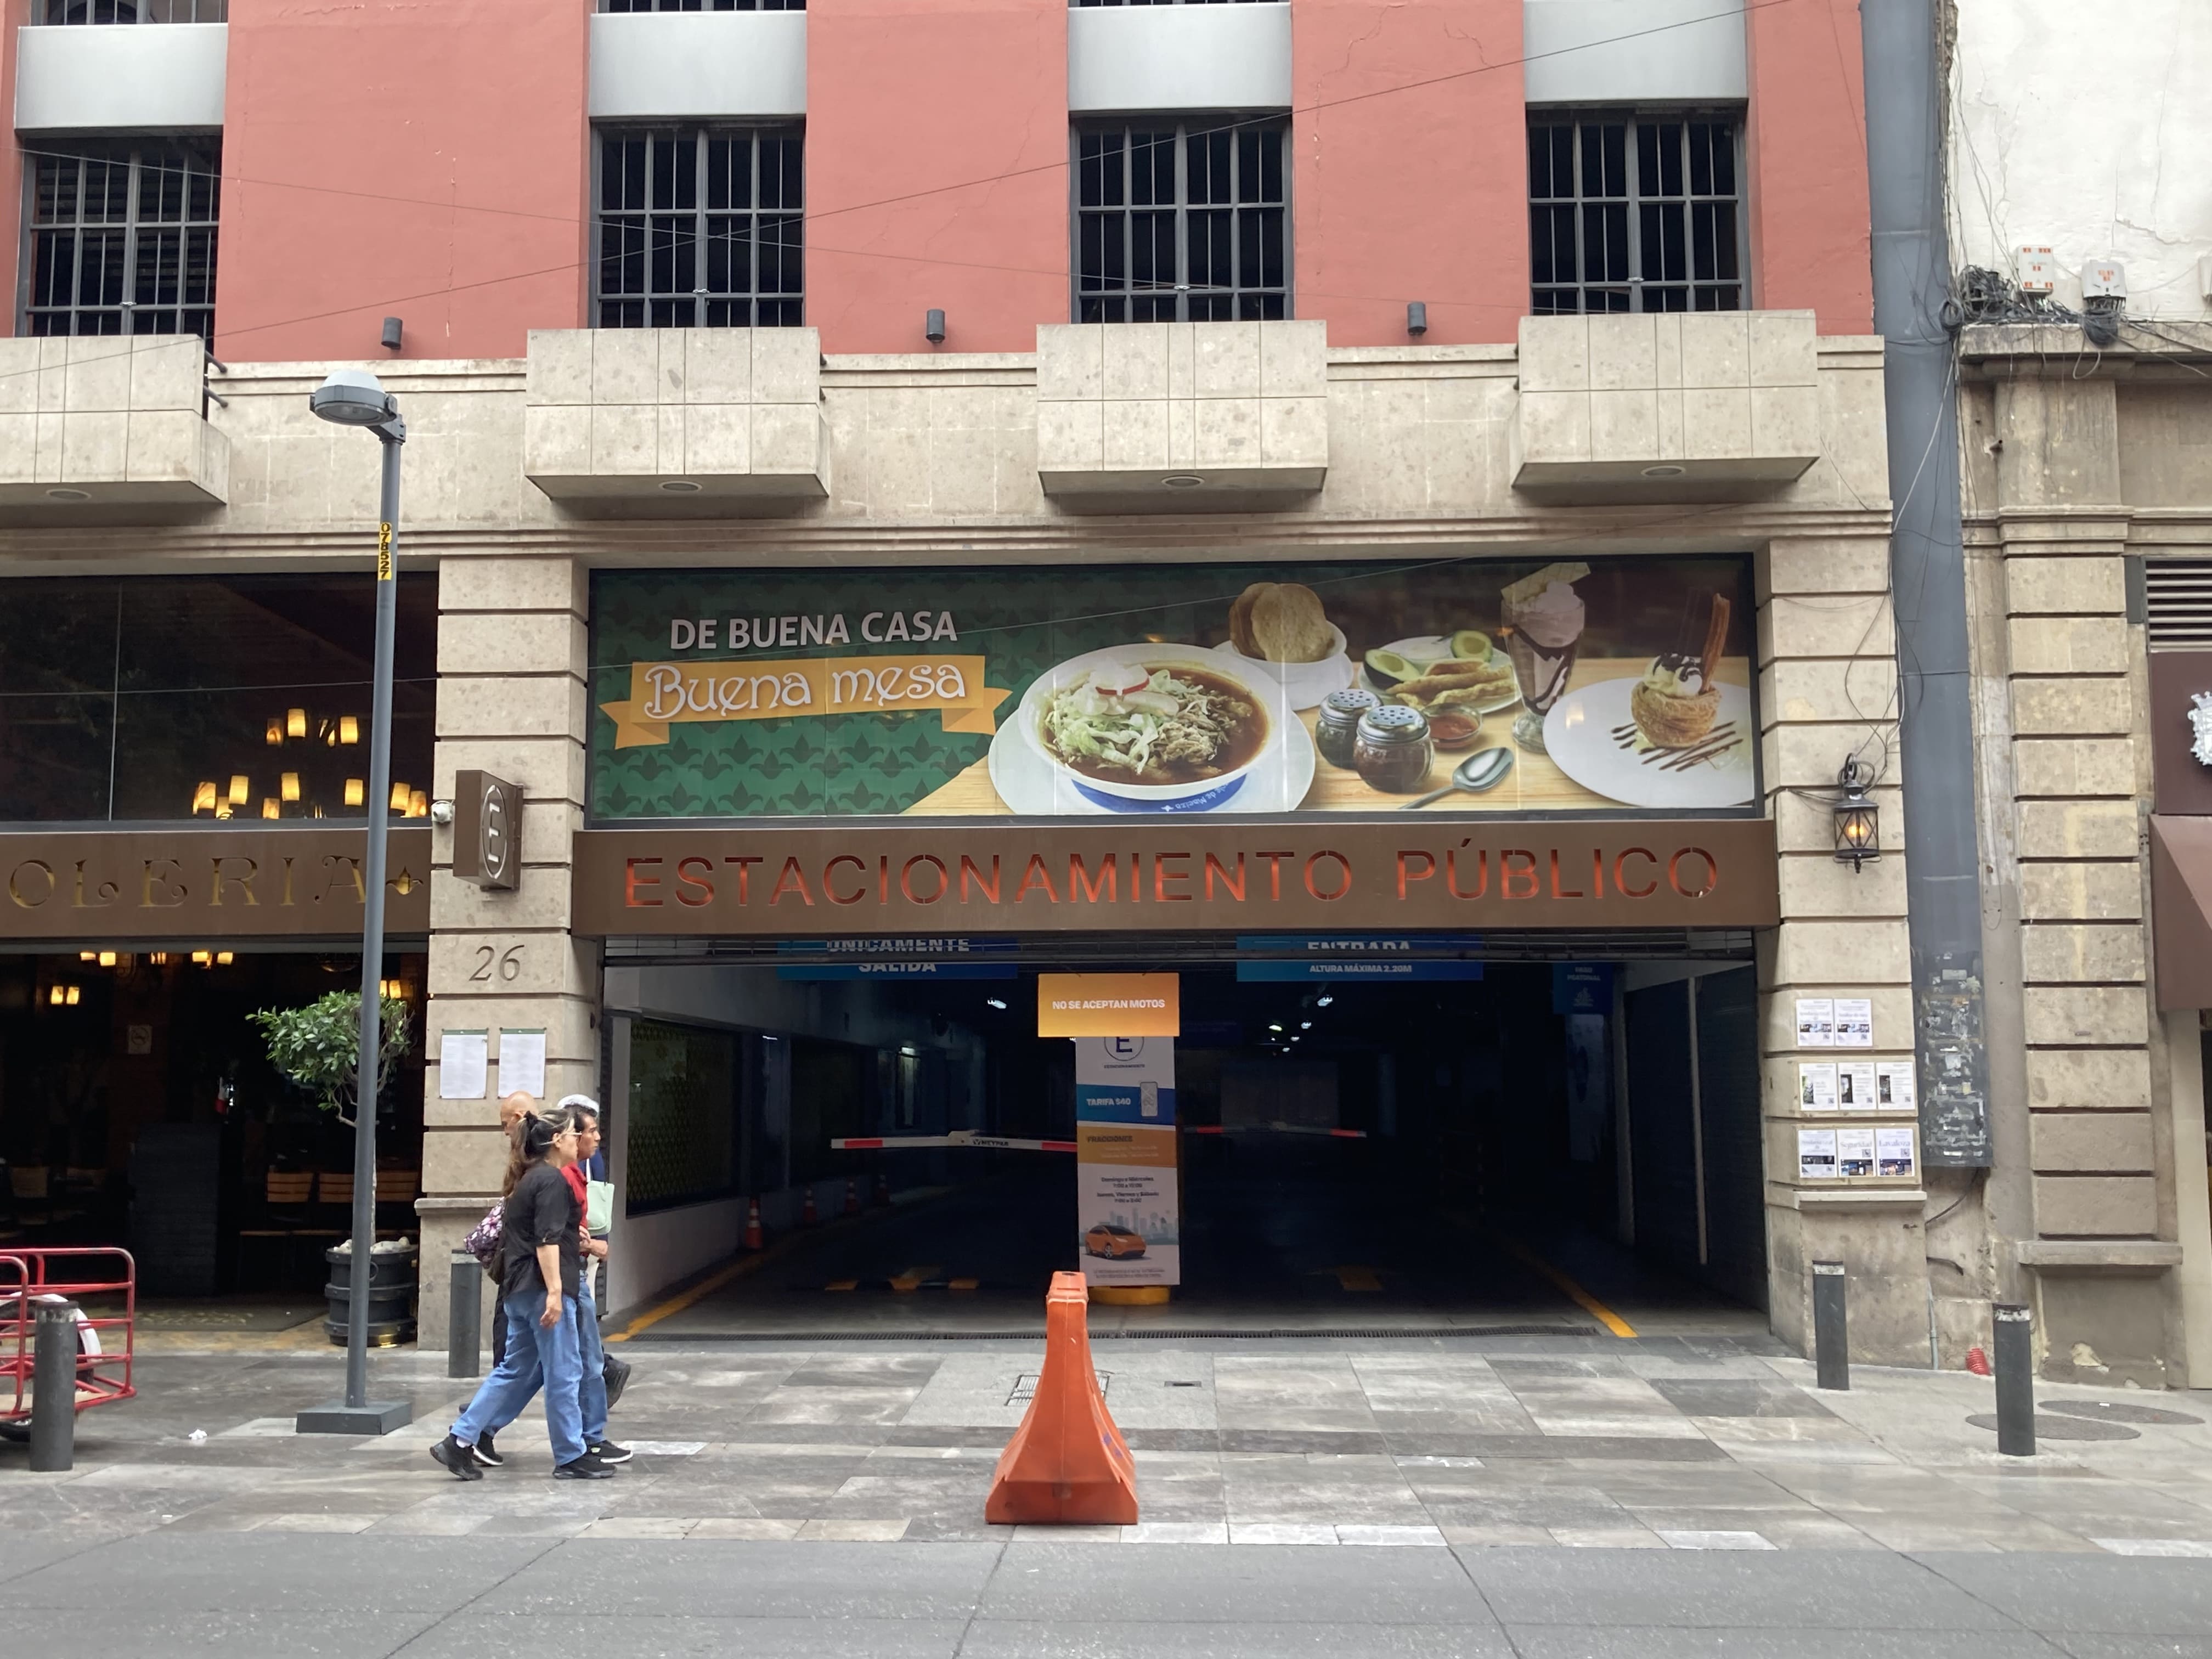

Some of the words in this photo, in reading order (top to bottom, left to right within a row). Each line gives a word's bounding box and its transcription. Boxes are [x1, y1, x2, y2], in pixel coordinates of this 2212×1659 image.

[670, 618, 718, 650] DE
[728, 613, 850, 650] BUENA
[861, 611, 958, 642] CASA
[644, 664, 812, 719] Buena
[832, 663, 967, 706] mesa
[625, 850, 1353, 908] ESTACIONAMIENTO
[1396, 838, 1718, 901] PÚBLICO
[469, 944, 525, 981] 26
[1310, 964, 1344, 973] ALTURA
[1344, 963, 1383, 973] MÁXIMA
[1052, 1001, 1067, 1009] NO
[1068, 1001, 1081, 1009] SE
[1082, 1000, 1128, 1009] ACEPTAN
[1129, 999, 1165, 1008] MOTOS
